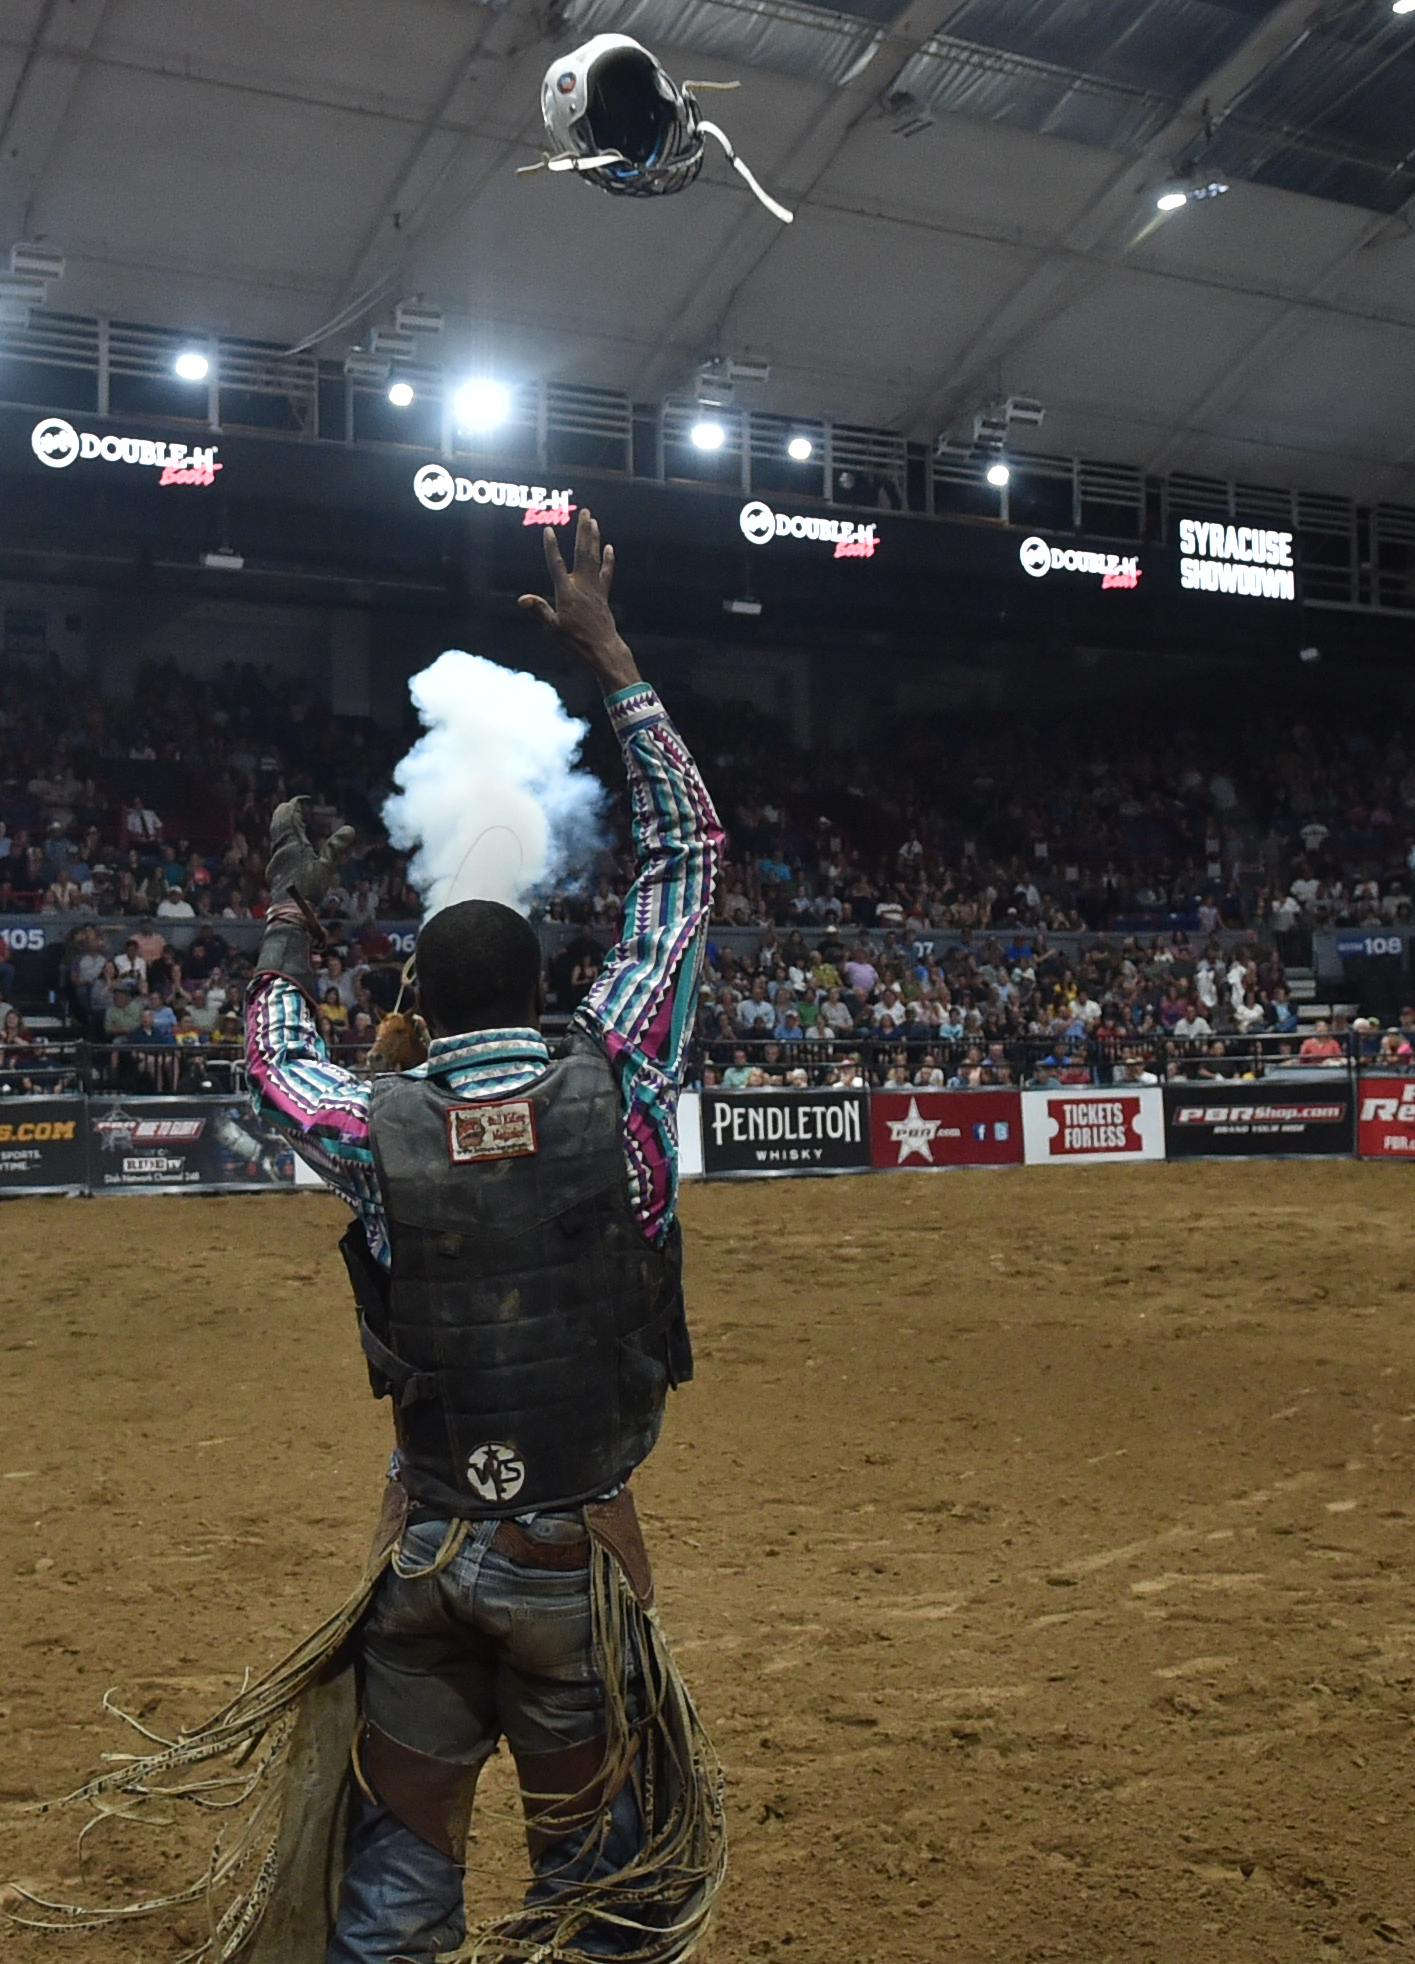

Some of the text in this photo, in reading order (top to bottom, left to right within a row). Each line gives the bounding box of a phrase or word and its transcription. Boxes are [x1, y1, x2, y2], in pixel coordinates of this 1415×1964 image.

[1179, 519, 1294, 567] SYRACUSE
[1180, 557, 1295, 601] SHOWDOWN
[1365, 936, 1402, 955] 108
[712, 1100, 861, 1145] PENDLETON
[1062, 1102, 1124, 1126] TICKETS
[755, 1148, 823, 1161] WHISKY
